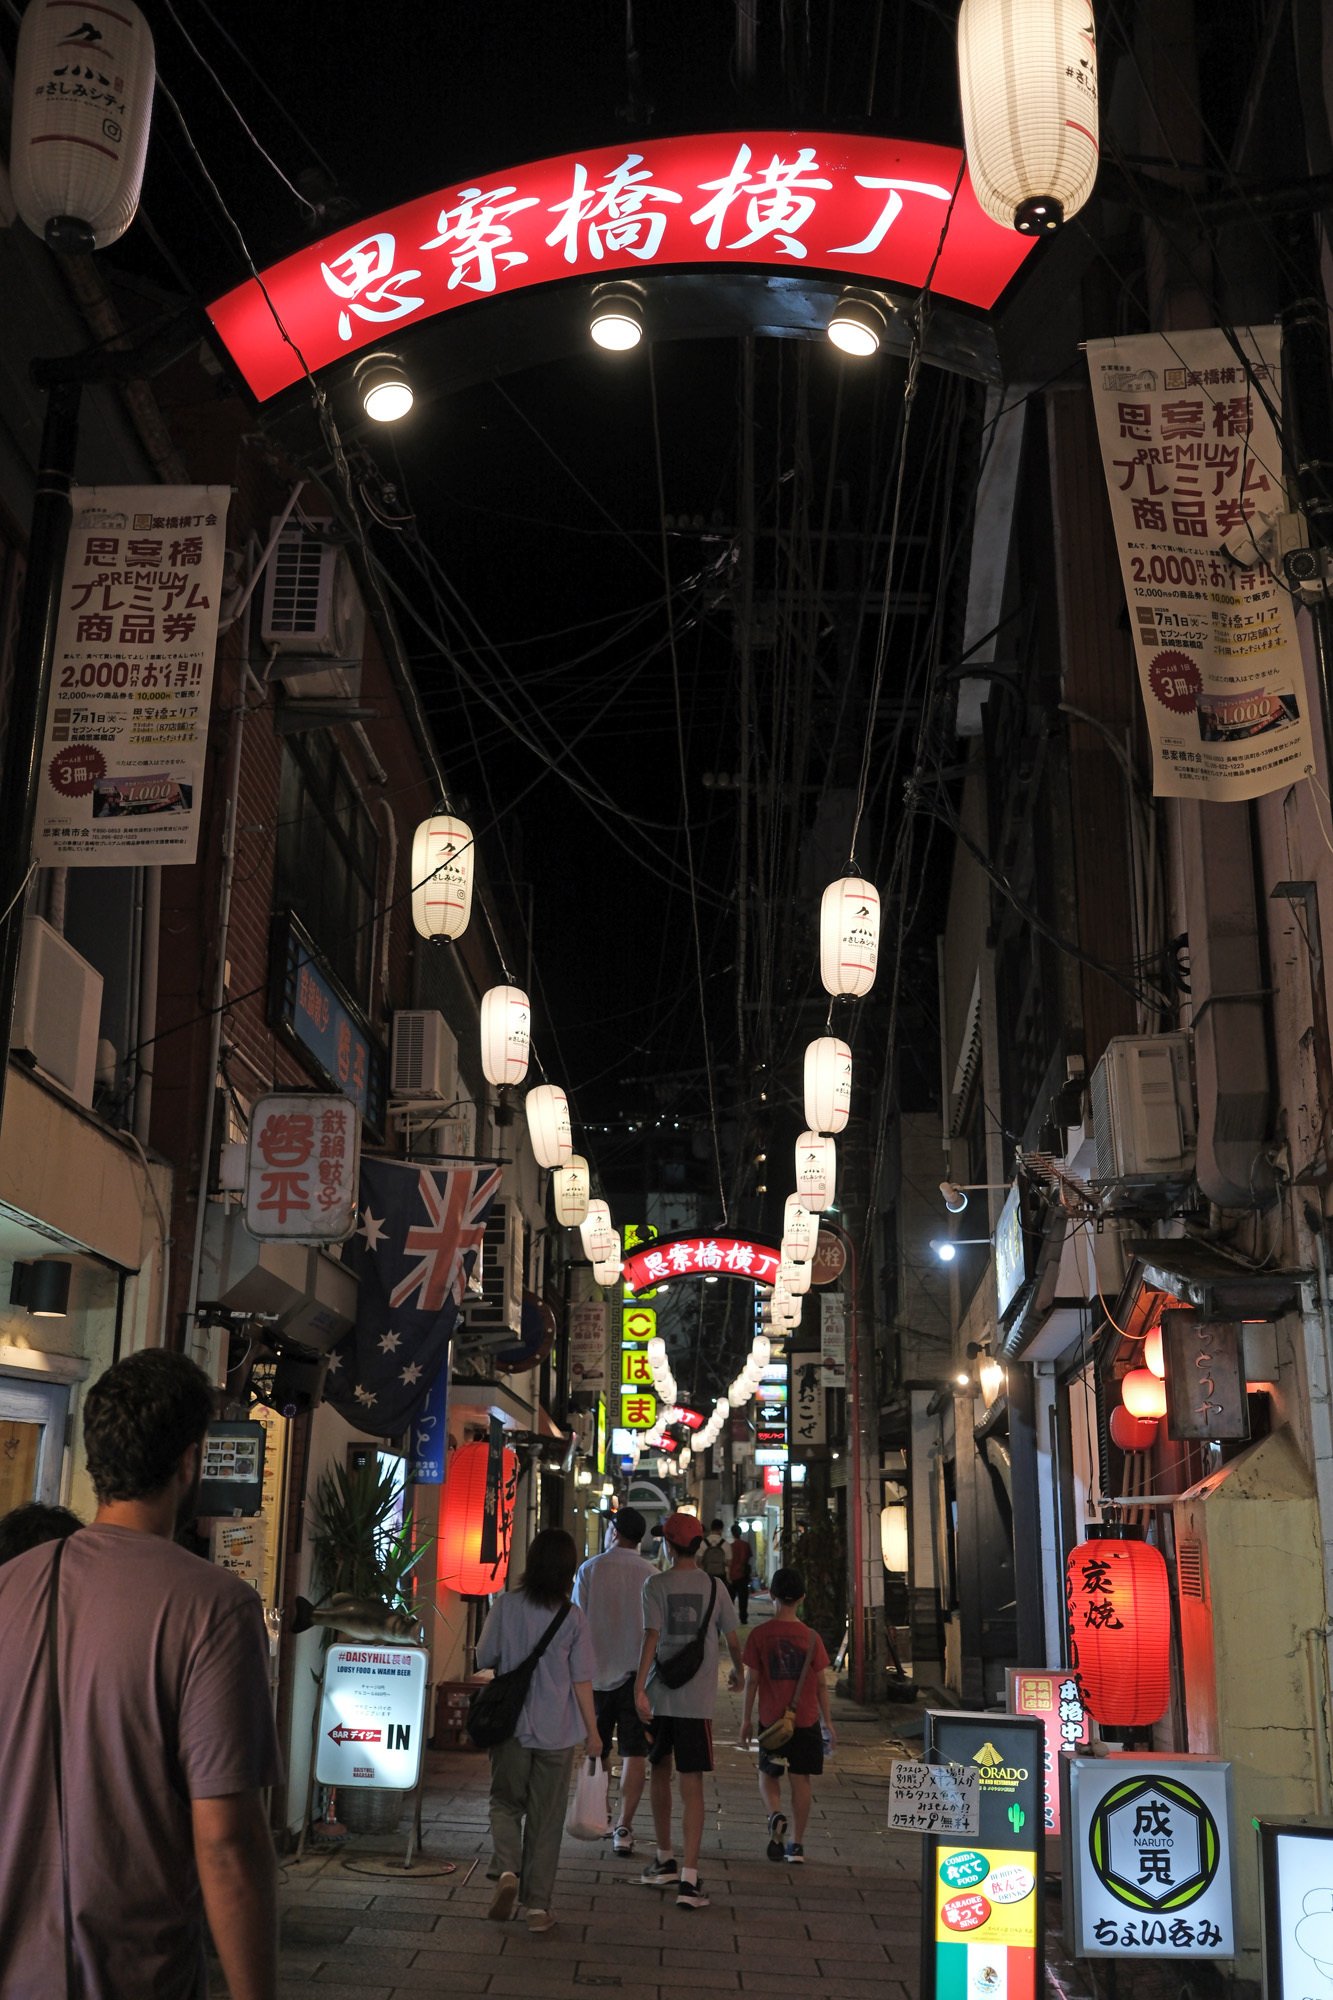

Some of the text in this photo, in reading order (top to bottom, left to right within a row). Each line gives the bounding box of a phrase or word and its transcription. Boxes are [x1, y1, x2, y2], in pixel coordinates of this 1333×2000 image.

[319, 142, 953, 342] 思案橋横丁
[1118, 395, 1254, 441] 思案橋
[1137, 443, 1240, 464] PREMIUM
[1112, 458, 1271, 497] プレミアム
[1130, 497, 1256, 537] 商品券
[84, 536, 204, 568] 思案橋
[98, 571, 190, 586] PREMIUM
[70, 581, 211, 612] プレミアム
[76, 613, 197, 644] 商品券
[431, 873, 467, 885] さしみシティ
[643, 1240, 780, 1280] 思案橋横丁
[812, 1245, 841, 1267] 火栓
[1081, 1559, 1124, 1630] 炭焼
[377, 1668, 396, 1676] WARM
[332, 1731, 349, 1739] BAR
[386, 1723, 411, 1751] IN
[978, 1766, 1029, 1781] ORADO
[892, 1813, 927, 1826] カラオケ
[1133, 1838, 1175, 1848] NARUTO
[944, 1852, 976, 1866] COMIDA
[946, 1859, 983, 1881] 食べて
[956, 1874, 979, 1886] FOOD
[944, 1895, 983, 1911] KARAOKE
[946, 1902, 984, 1924] 歌って
[959, 1917, 979, 1928] SING
[1092, 1917, 1223, 1948] ちょい呑み
